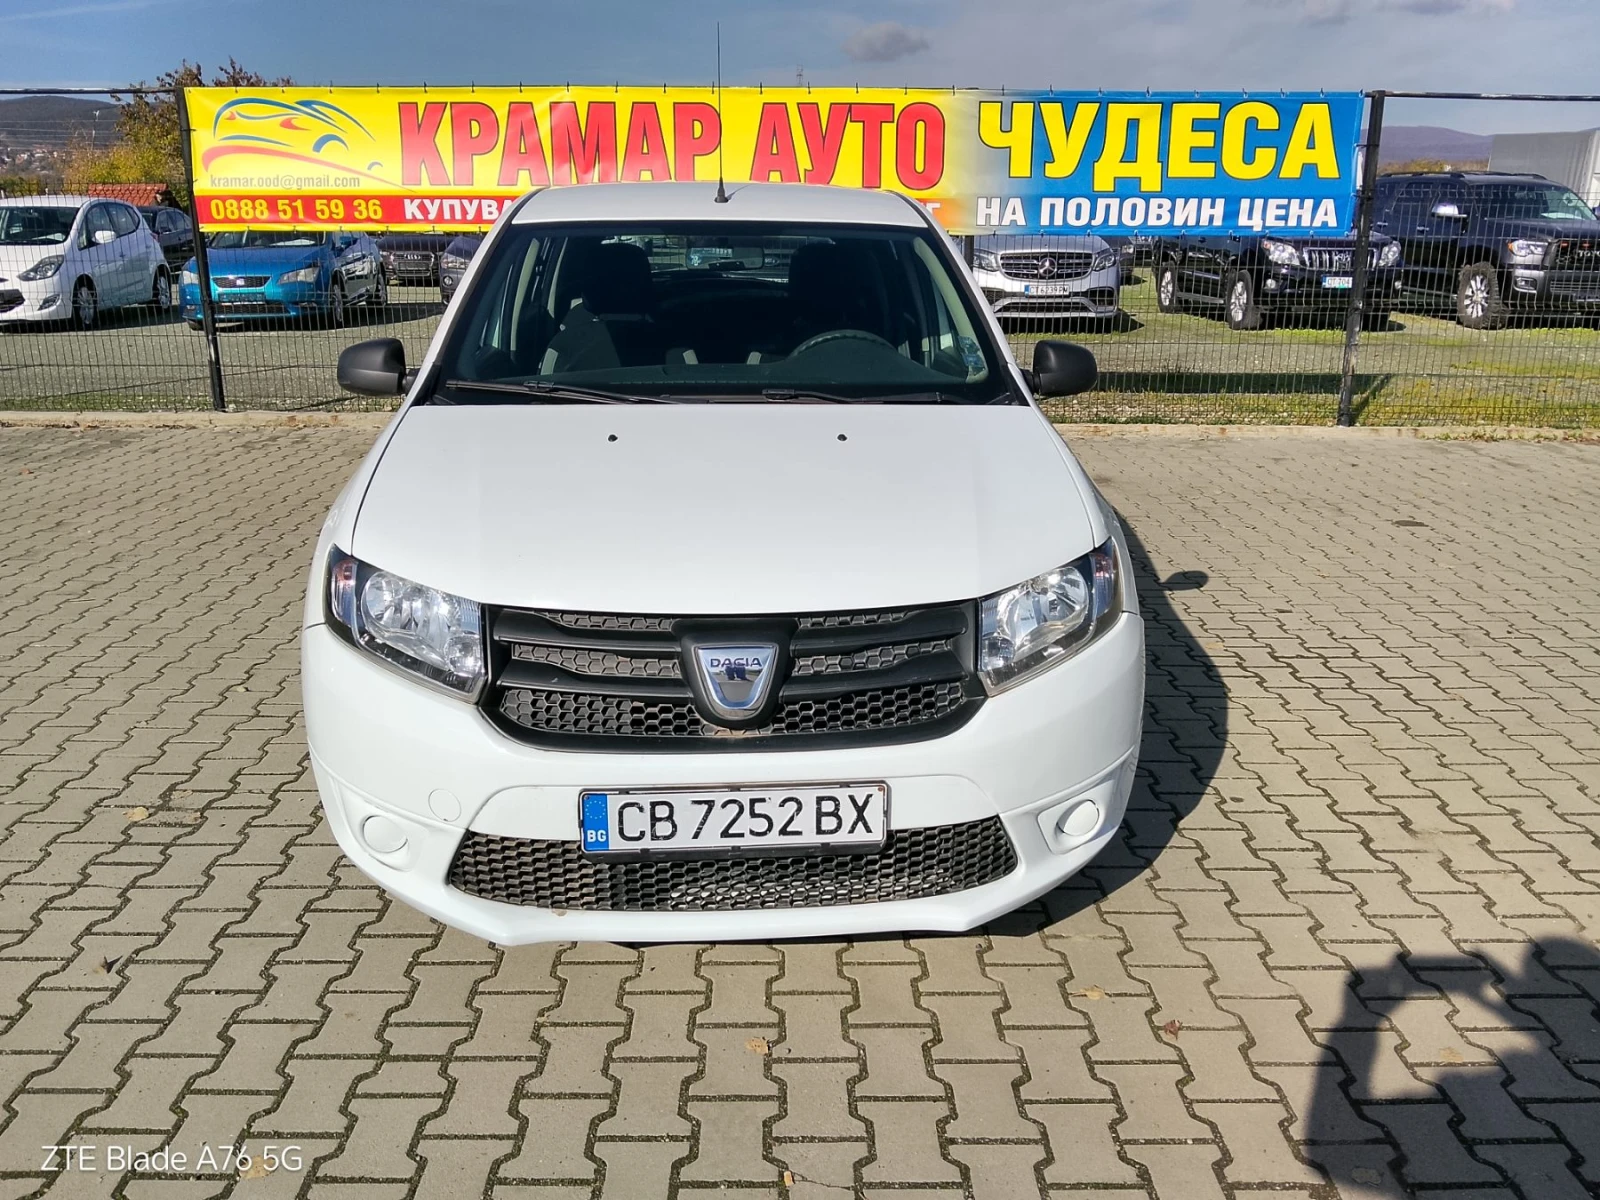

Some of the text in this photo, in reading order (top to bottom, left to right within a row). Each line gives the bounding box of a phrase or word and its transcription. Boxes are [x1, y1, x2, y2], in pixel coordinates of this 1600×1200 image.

[398, 101, 945, 190] КРАМАР АУТО
[978, 101, 1340, 193] ЧУДЕСА
[210, 175, 360, 190] kramar.ood@gmail.com
[210, 199, 383, 220] 0888 51 59 36
[976, 197, 1027, 226] НА
[1040, 198, 1226, 228] ПОЛОВИН
[1238, 199, 1338, 231] ЦЕНА
[710, 657, 763, 668] DACIA
[618, 793, 873, 842] CB 7252 BX
[587, 829, 607, 843] BG
